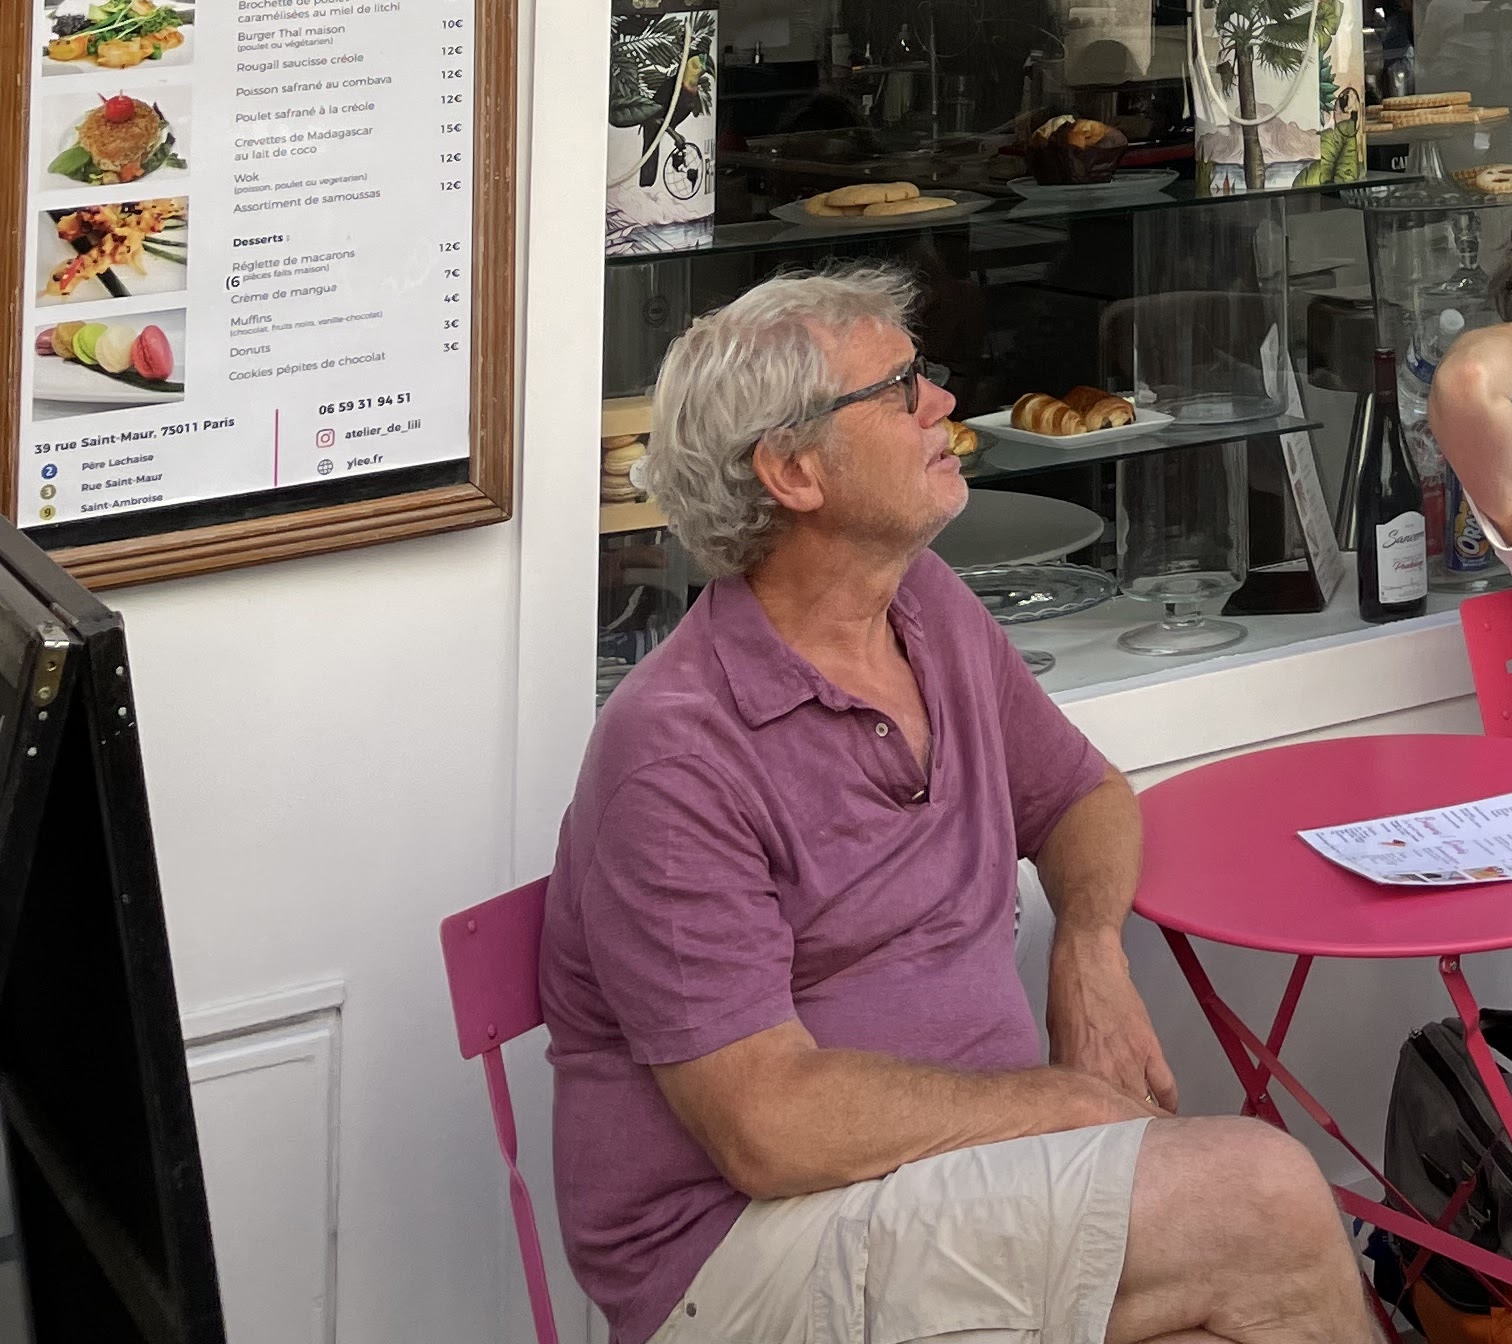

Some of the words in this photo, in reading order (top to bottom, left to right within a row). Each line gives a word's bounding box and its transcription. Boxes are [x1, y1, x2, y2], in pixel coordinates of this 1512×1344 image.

[442, 19, 463, 29] 10€
[238, 30, 275, 43] Burger
[305, 25, 345, 35] maison
[441, 46, 463, 55] 12€
[282, 57, 327, 69] saucisse
[330, 53, 364, 64] créole
[441, 70, 463, 79] 12€
[236, 85, 279, 98] Poisson
[282, 80, 322, 94] safrané
[325, 80, 339, 89] au
[342, 76, 392, 88] combava
[441, 94, 462, 104] 12€
[236, 111, 271, 123] Poulet
[274, 106, 316, 119] safrané
[319, 105, 326, 115] à
[328, 105, 338, 114] la
[341, 102, 375, 112] créole
[440, 124, 462, 133] 15€
[440, 153, 462, 163] 12€
[234, 172, 259, 183] Wok
[440, 181, 461, 191] 12€
[233, 234, 284, 247] Desserts
[439, 242, 461, 252] 12€
[444, 269, 460, 279] 7€
[444, 294, 460, 303] 4€
[230, 314, 272, 327] Muffins
[444, 319, 459, 329] 3€
[230, 344, 271, 357] Donuts
[443, 342, 459, 352] 3€
[229, 368, 273, 381] Cookies
[276, 362, 318, 377] pépites
[321, 359, 335, 369] de
[338, 352, 386, 366] chocolat
[319, 404, 334, 414] 06
[339, 401, 354, 412] 59
[358, 399, 372, 409] 31
[377, 395, 393, 407] 94
[397, 392, 411, 403] 51
[34, 444, 51, 454] 39
[55, 441, 77, 452] rue
[161, 422, 198, 437] 75011
[203, 417, 235, 430] Paris
[347, 454, 383, 470] ylee.fr
[81, 483, 102, 492] Rue
[106, 473, 162, 488] Saint-Maur
[81, 494, 163, 513] Saint-Ambroise
